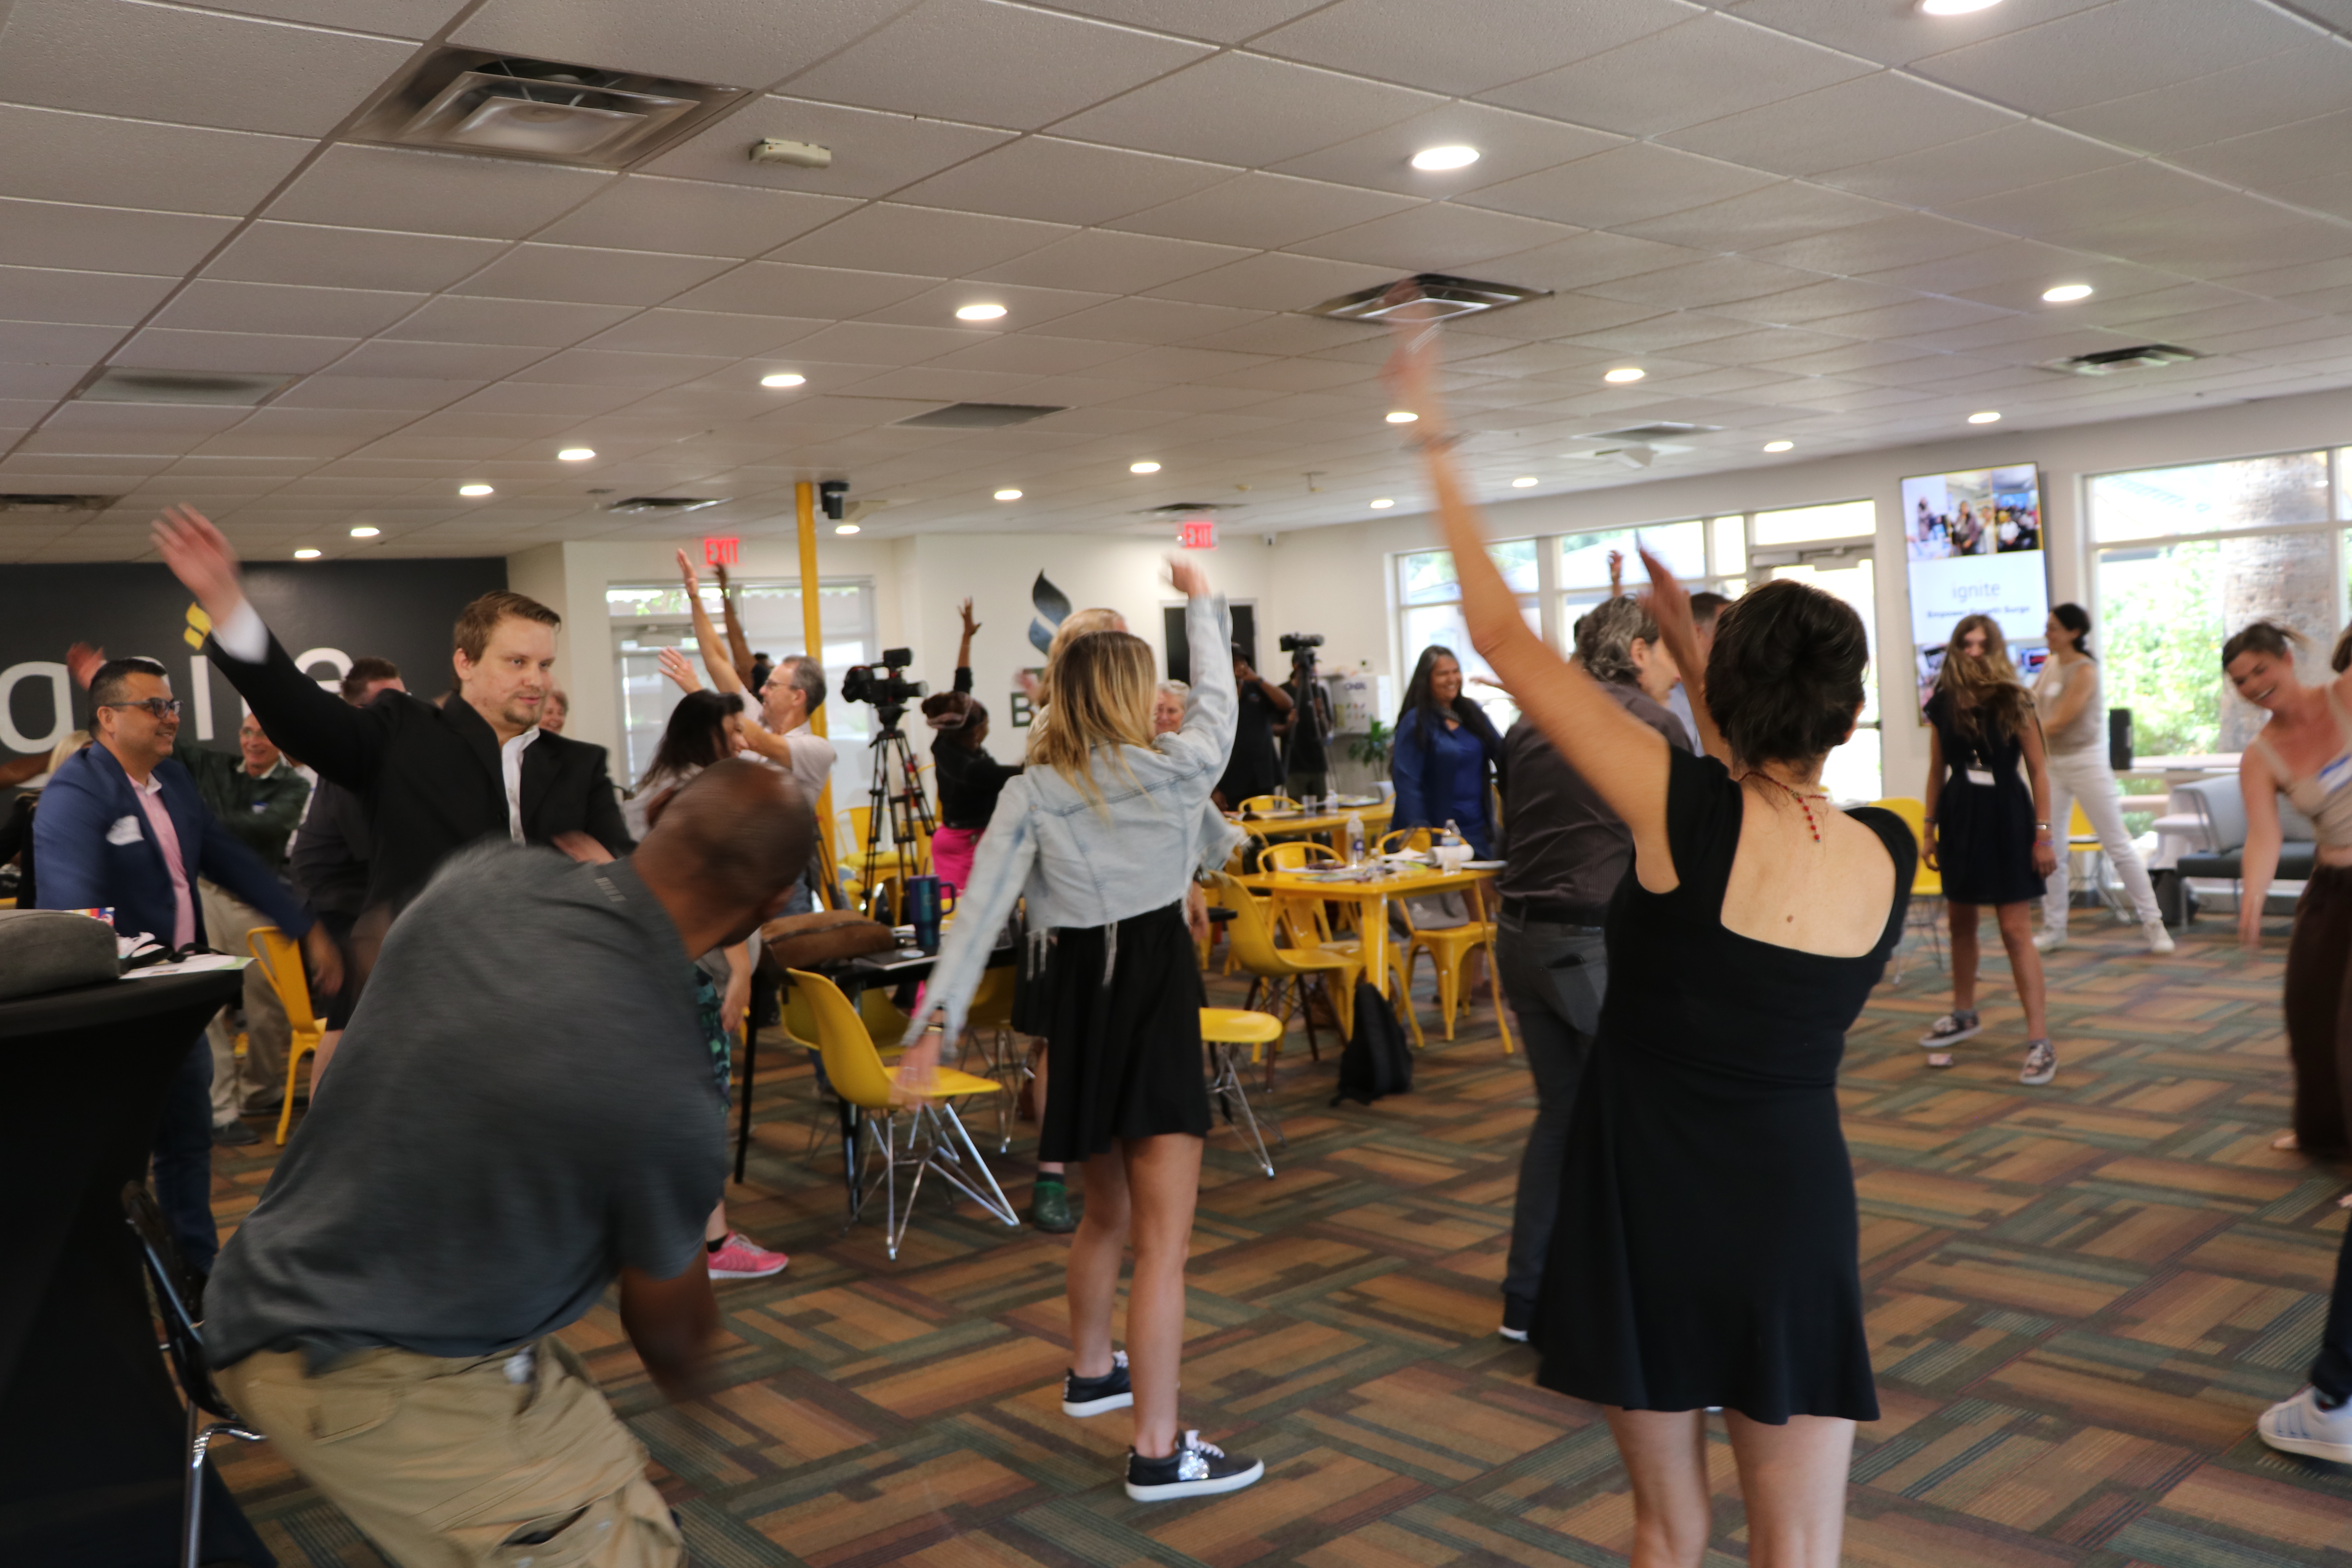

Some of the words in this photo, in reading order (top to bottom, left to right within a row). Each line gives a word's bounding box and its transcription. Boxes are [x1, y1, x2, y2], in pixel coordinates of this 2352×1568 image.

[1185, 523, 1213, 547] EXIT
[704, 538, 740, 564] EXIT
[1951, 581, 2001, 603] ignite
